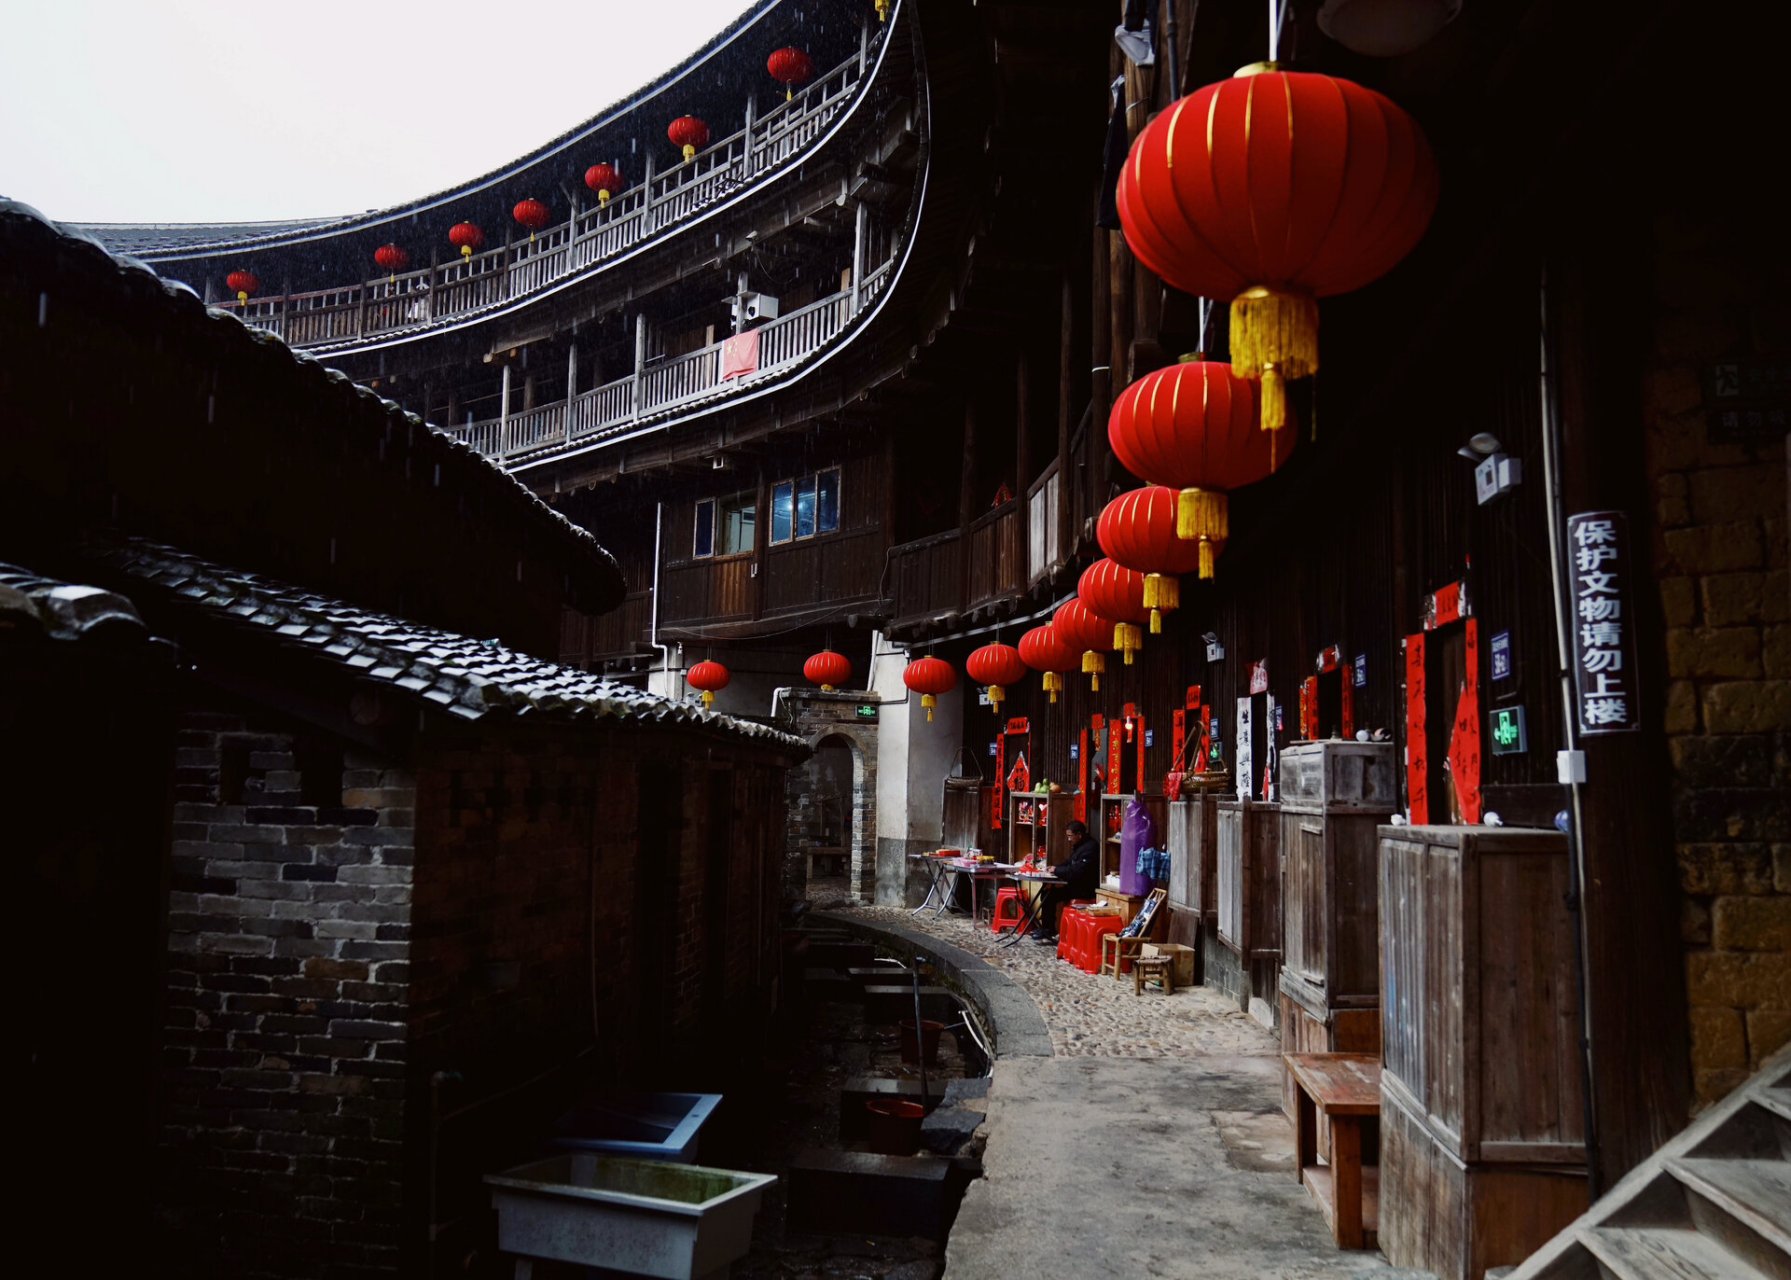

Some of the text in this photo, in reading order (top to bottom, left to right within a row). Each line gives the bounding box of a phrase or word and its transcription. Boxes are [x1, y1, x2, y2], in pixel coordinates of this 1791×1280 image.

[1574, 519, 1627, 725] 保护文物请勿上楼
